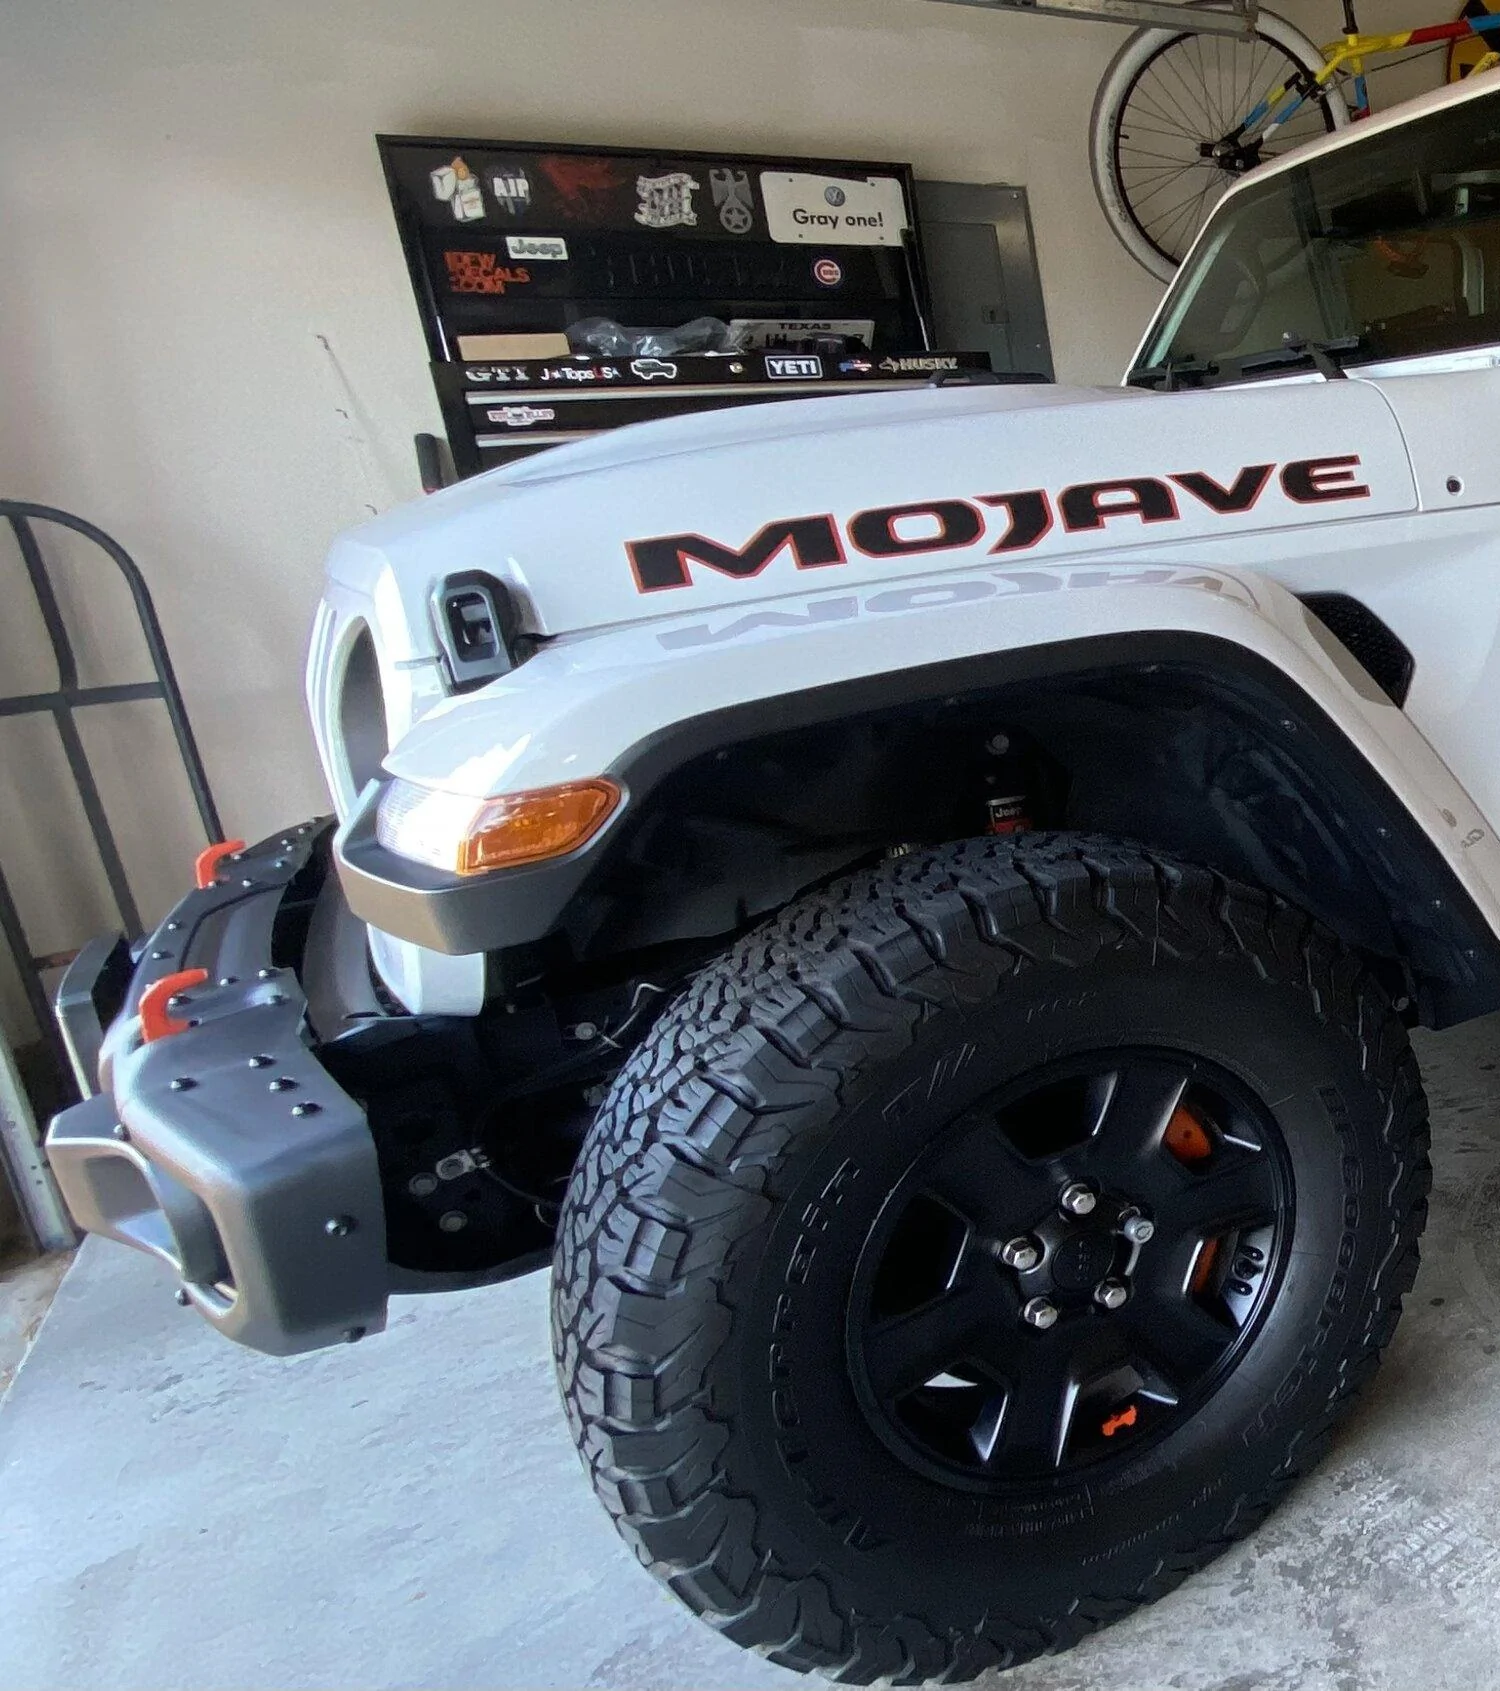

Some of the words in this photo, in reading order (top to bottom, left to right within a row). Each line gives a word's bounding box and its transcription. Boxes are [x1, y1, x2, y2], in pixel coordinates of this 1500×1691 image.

[793, 208, 839, 229] Gray
[845, 211, 884, 228] one!
[510, 239, 564, 258] Jeep
[778, 322, 832, 332] TEXAS
[769, 360, 818, 376] YETI
[900, 357, 958, 371] HUSKY
[465, 366, 530, 382] GTI
[623, 454, 1371, 595] MOJAVE
